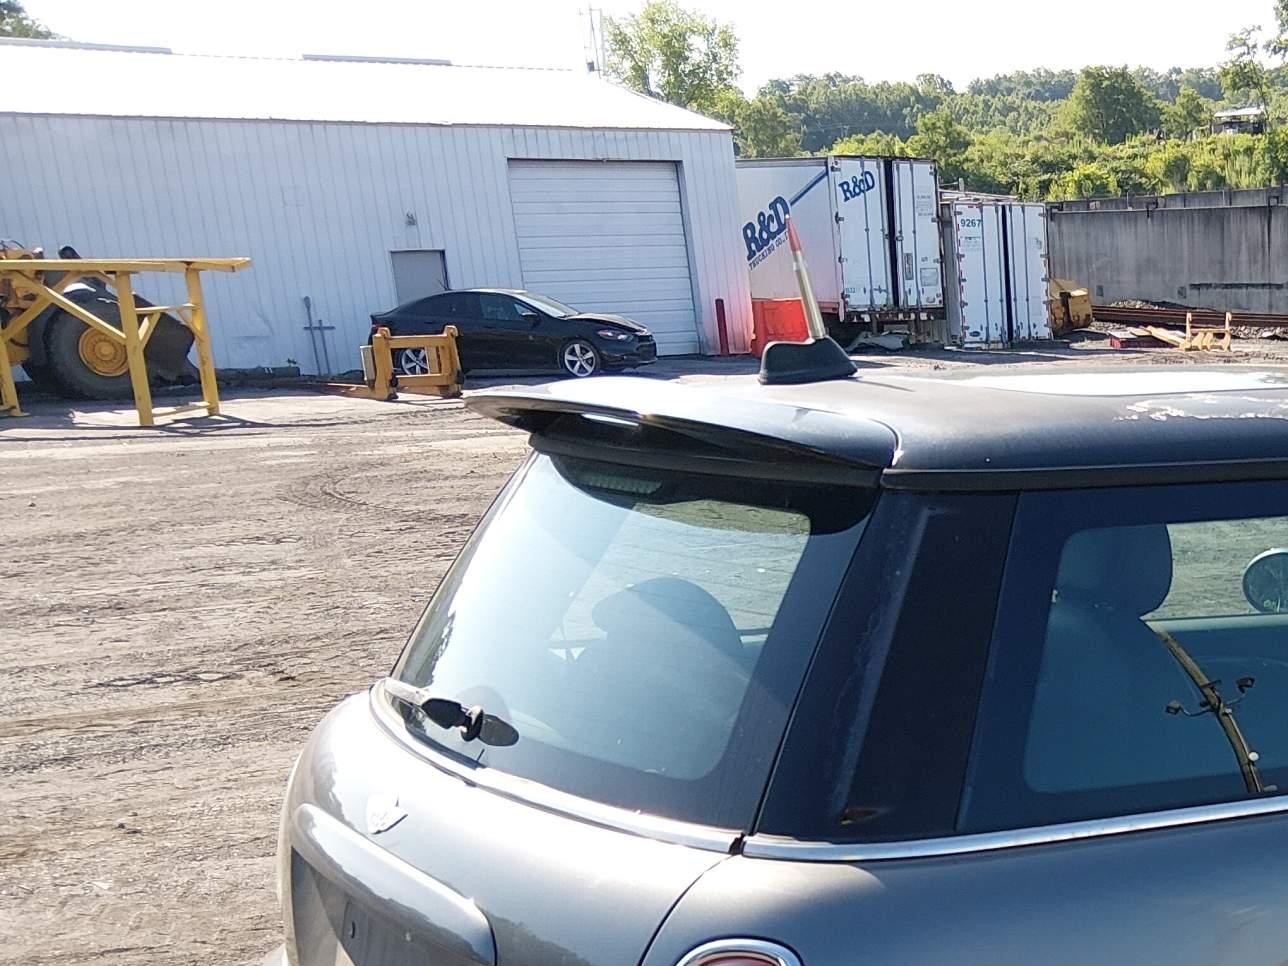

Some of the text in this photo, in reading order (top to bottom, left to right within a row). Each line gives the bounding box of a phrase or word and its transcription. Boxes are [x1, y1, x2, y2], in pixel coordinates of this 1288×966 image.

[838, 171, 875, 202] R&D
[743, 196, 789, 261] R&D
[960, 219, 981, 228] 9267
